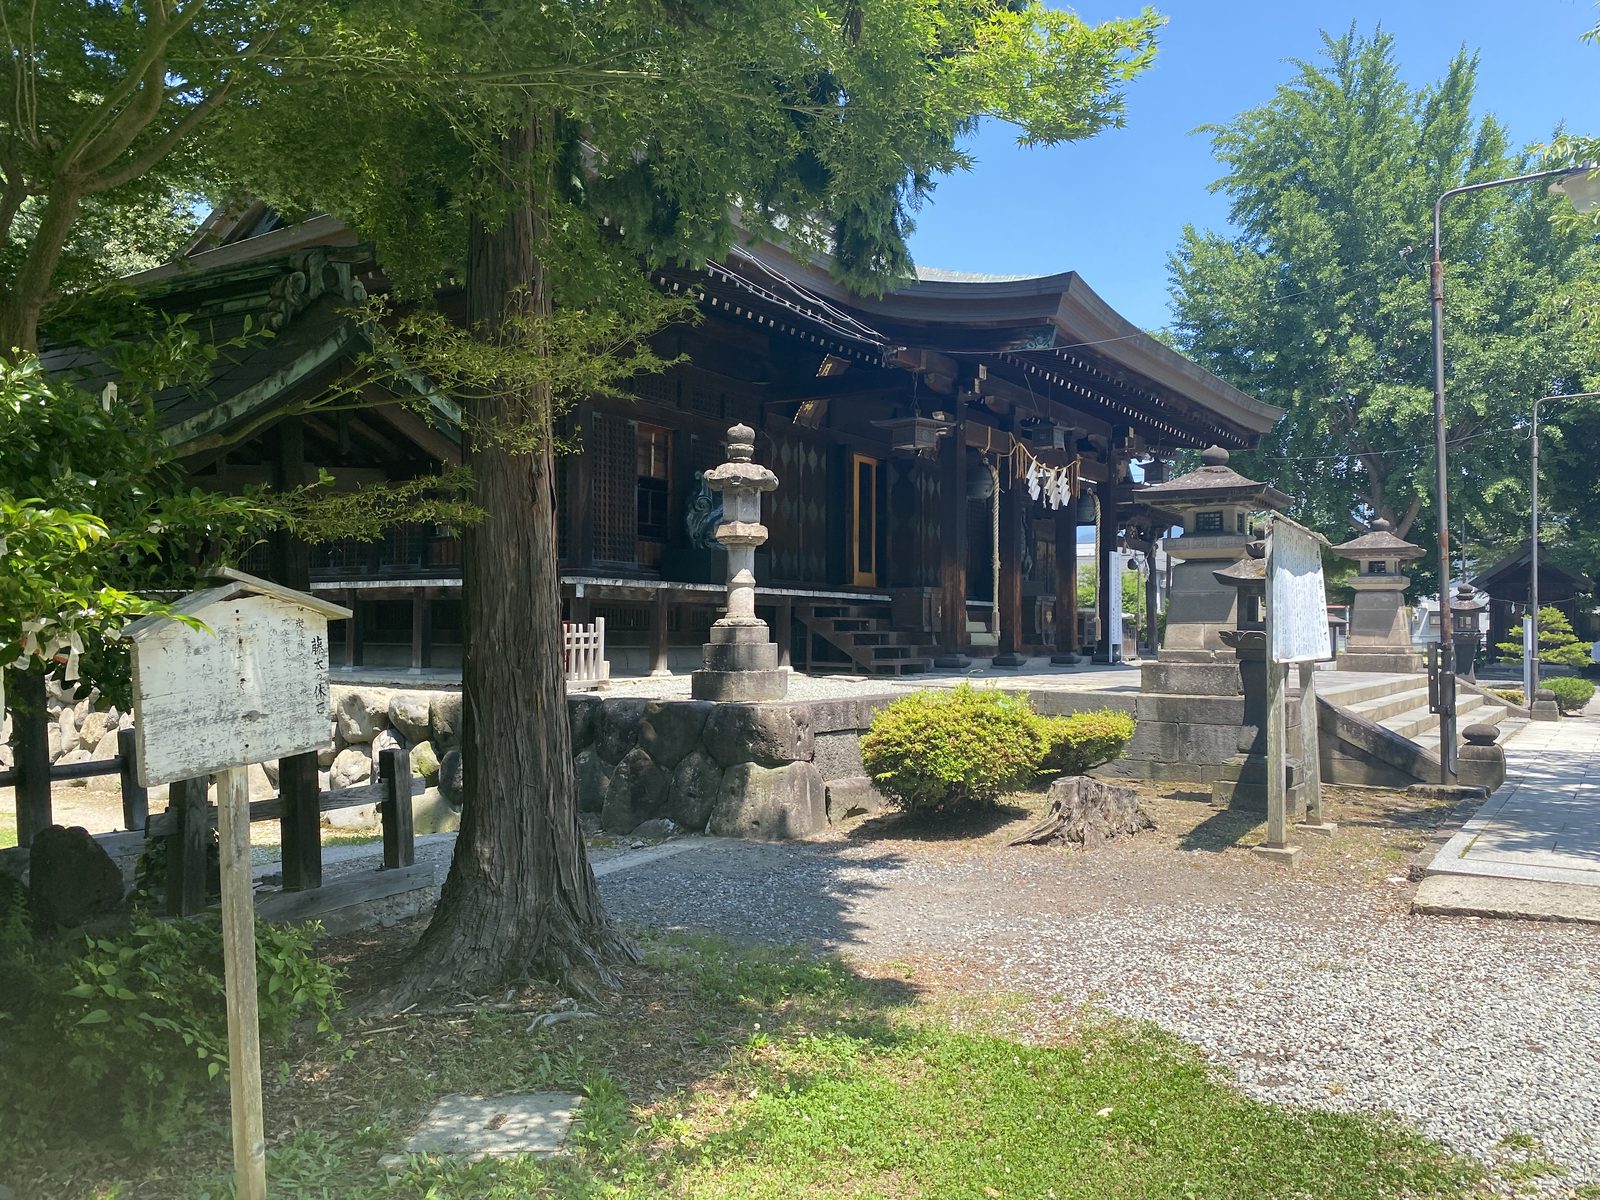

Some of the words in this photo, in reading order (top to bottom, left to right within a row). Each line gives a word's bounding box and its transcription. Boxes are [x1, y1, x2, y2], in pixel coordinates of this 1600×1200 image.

[310, 635, 327, 715] 藤太の休石
